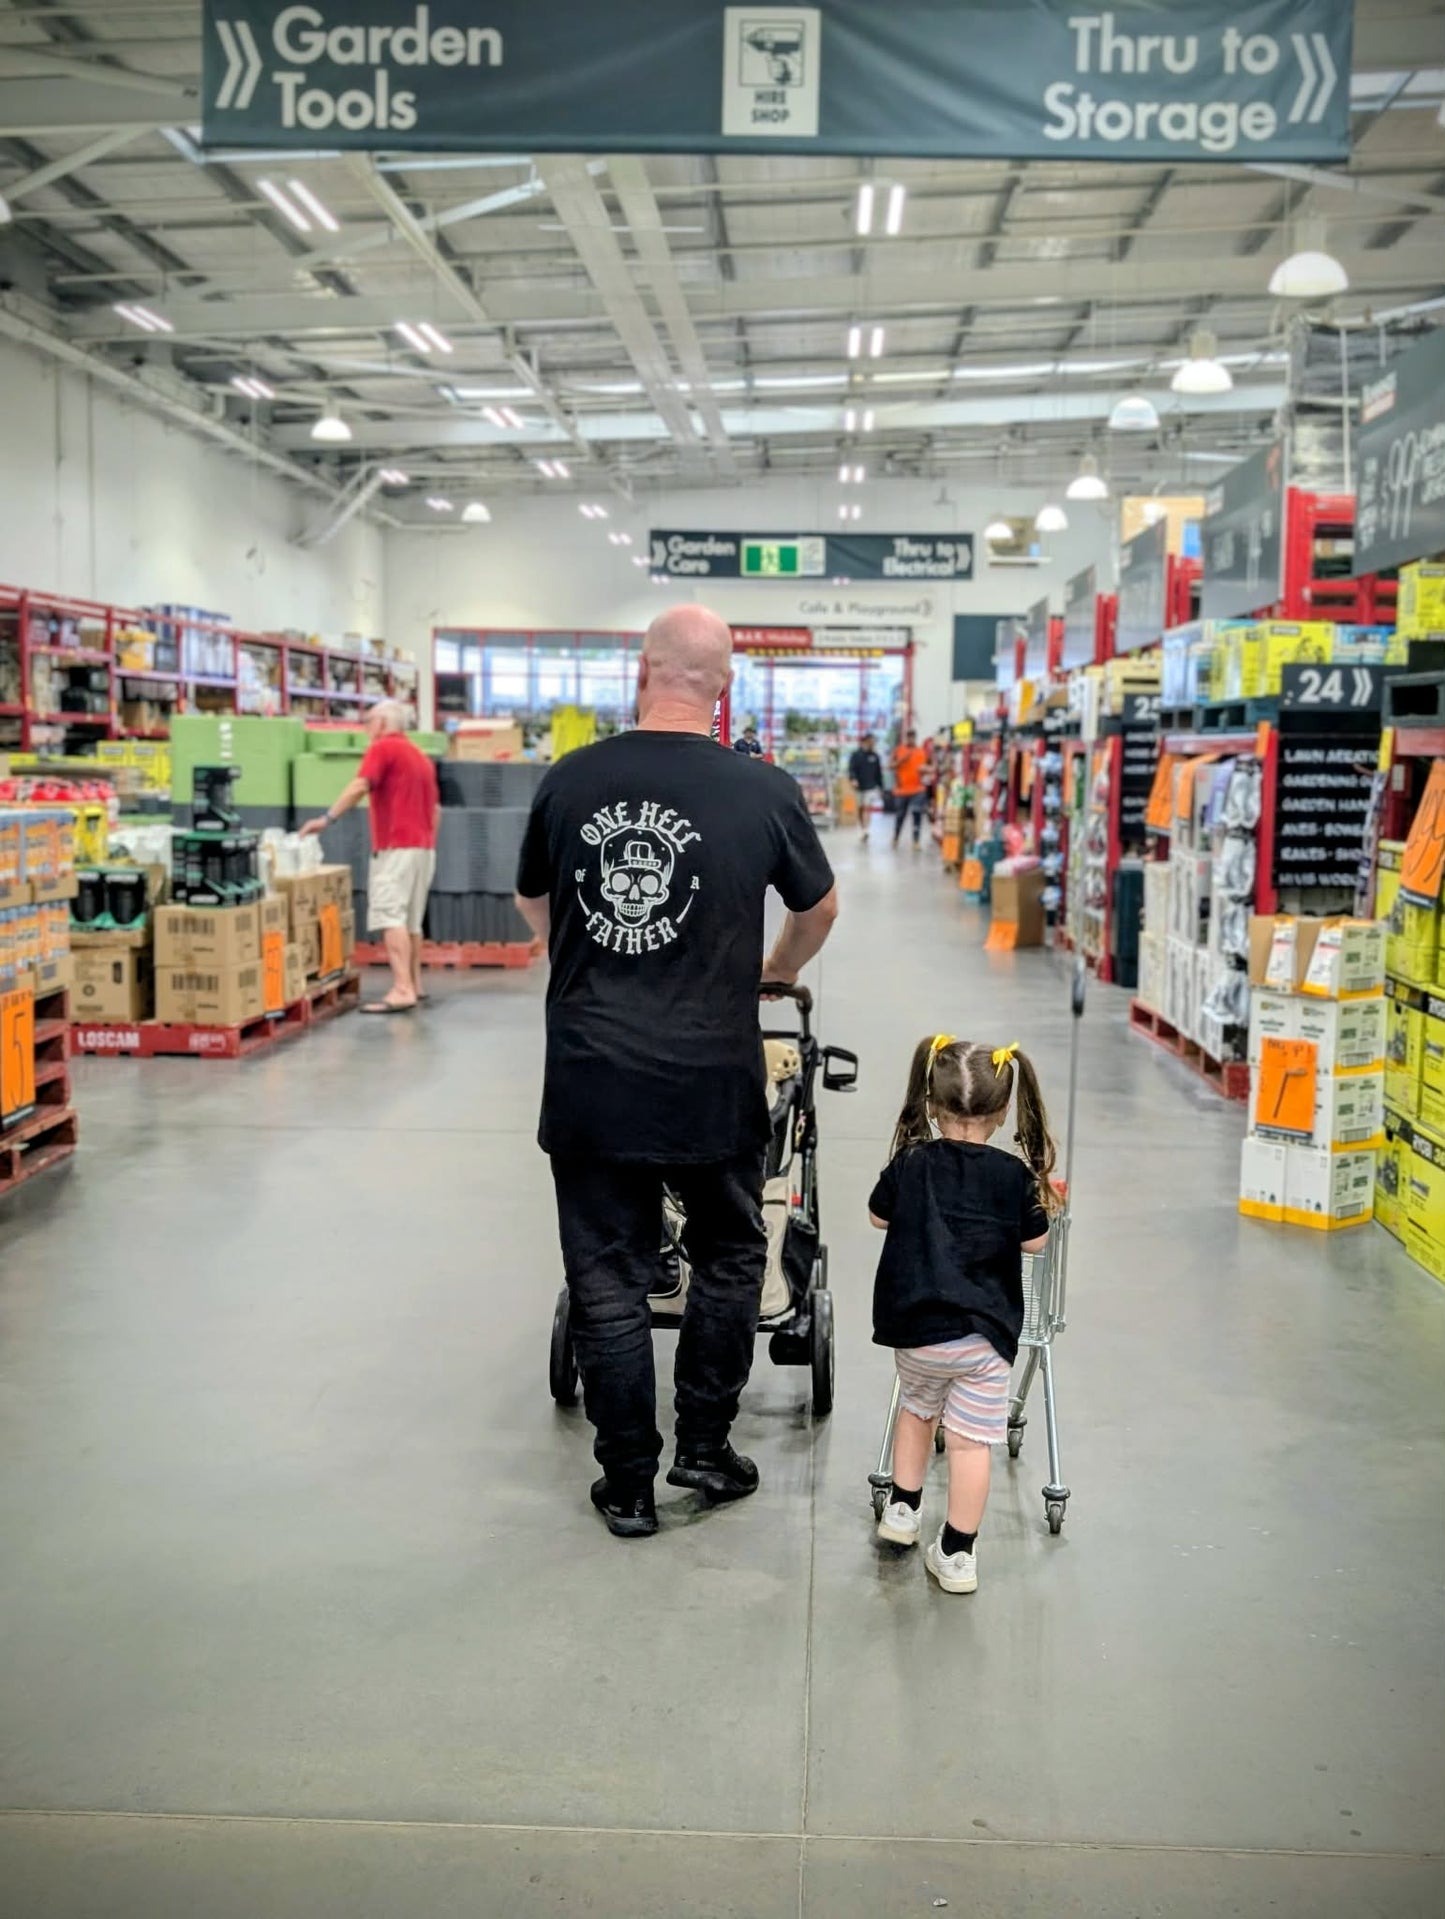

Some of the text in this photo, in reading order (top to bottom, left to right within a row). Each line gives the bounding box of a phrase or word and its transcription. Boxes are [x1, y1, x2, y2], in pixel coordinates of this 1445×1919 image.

[272, 5, 502, 67] Garden
[1068, 16, 1280, 75] Thru to
[272, 70, 417, 130] Tools
[754, 90, 787, 104] HIRE
[751, 108, 790, 123] SHOP
[1043, 82, 1277, 153] Storage
[667, 535, 736, 556] Garden
[893, 537, 955, 557] Thru to
[667, 554, 711, 574] Care
[882, 556, 956, 577] Electrical
[800, 601, 828, 615] Cafe
[848, 602, 921, 617] Playground
[1298, 668, 1344, 704] 24
[580, 800, 702, 853] ONE HELL
[689, 875, 701, 891] A
[585, 911, 678, 954] FATHER
[77, 1031, 140, 1048] LOSCAM
